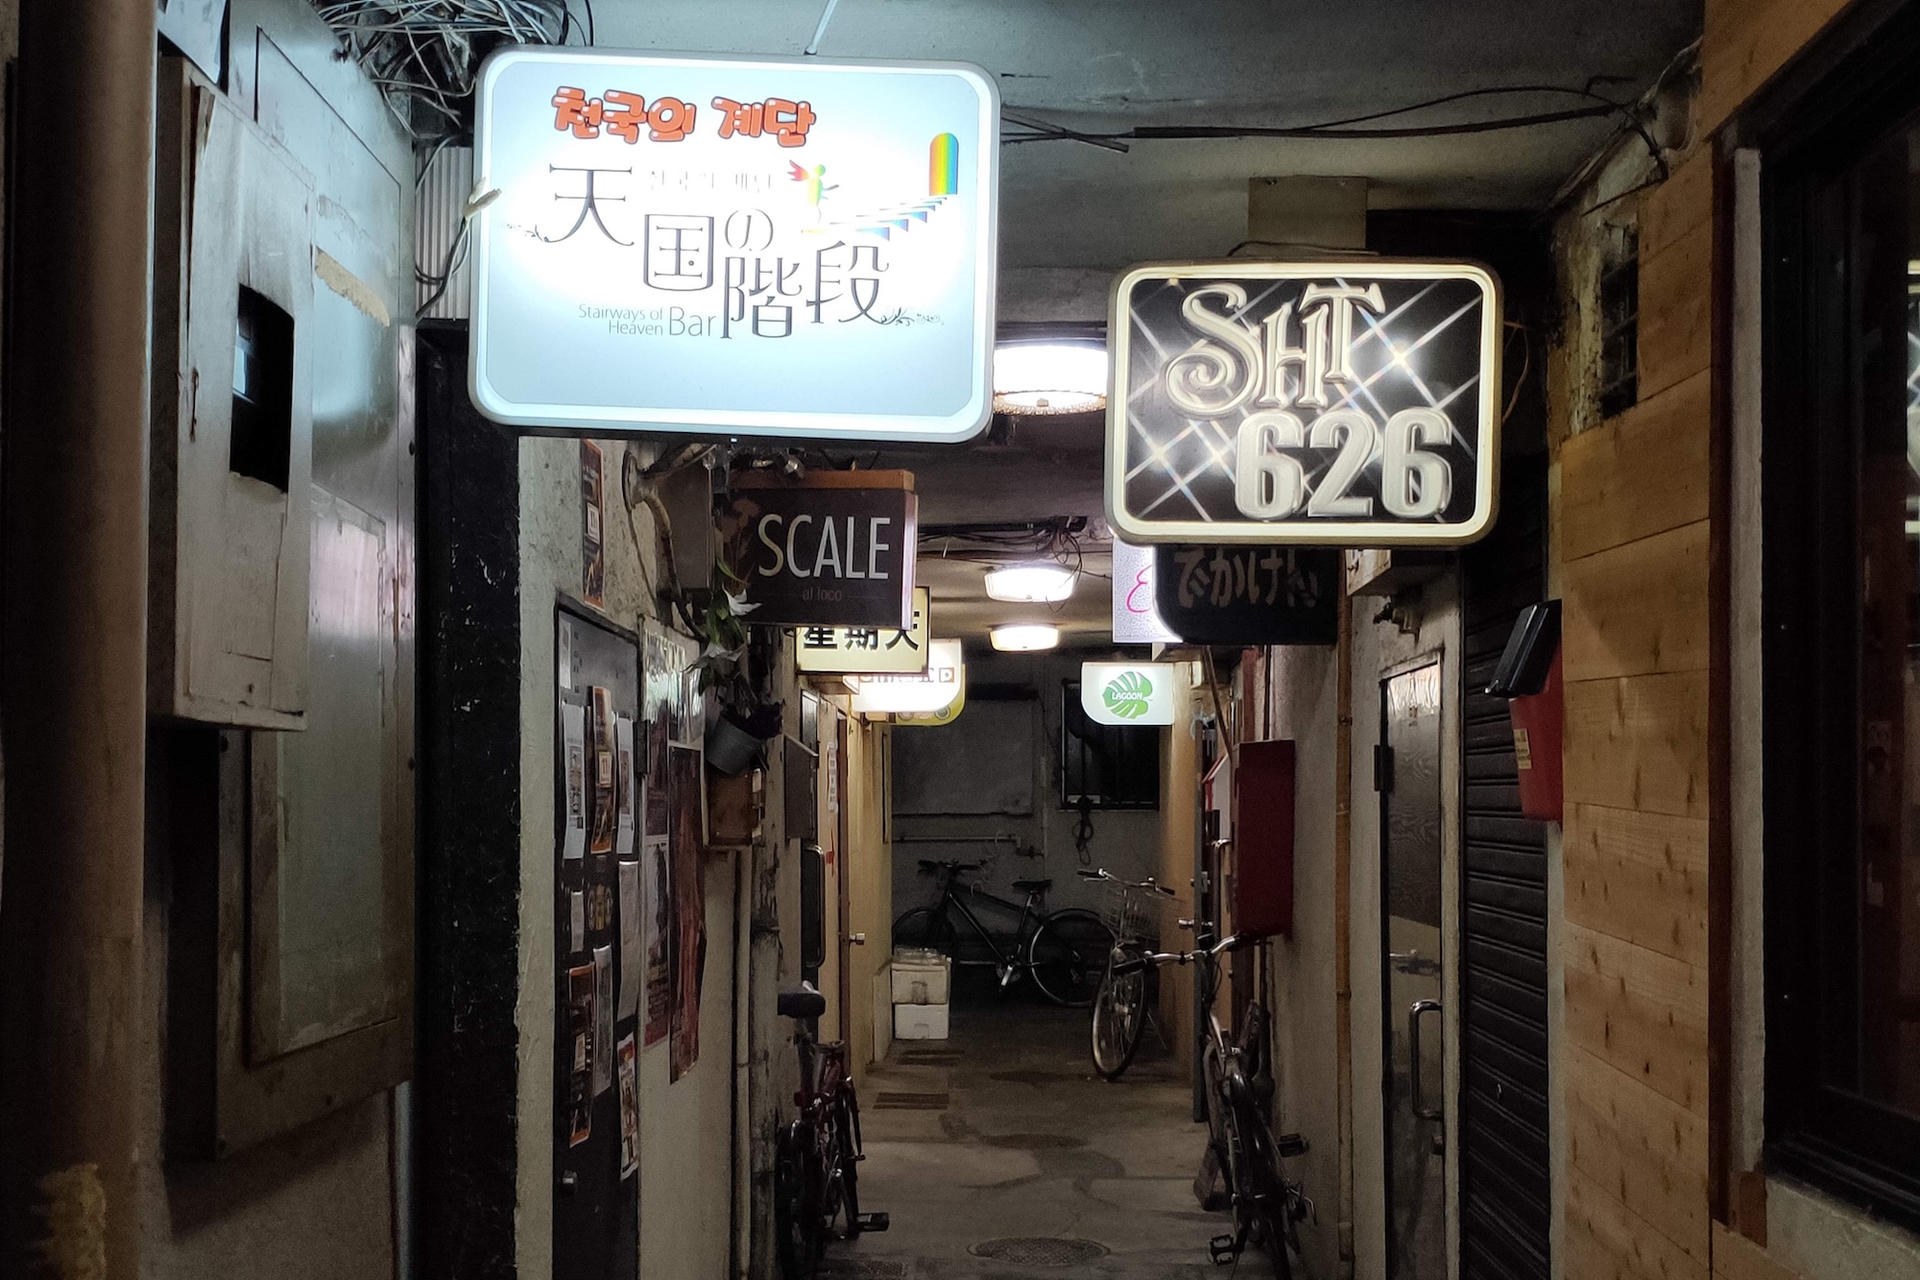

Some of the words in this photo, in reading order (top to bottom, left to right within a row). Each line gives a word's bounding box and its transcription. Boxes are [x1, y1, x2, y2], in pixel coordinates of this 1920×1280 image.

[552, 86, 697, 144] 천국의
[711, 96, 817, 147] 계단
[578, 304, 646, 323] Stairways
[650, 307, 664, 320] of
[608, 320, 664, 336] Heaven
[669, 306, 717, 337] Bar
[1235, 409, 1453, 520] 626
[758, 514, 891, 579] SCALE
[1112, 691, 1145, 701] LAGOON
